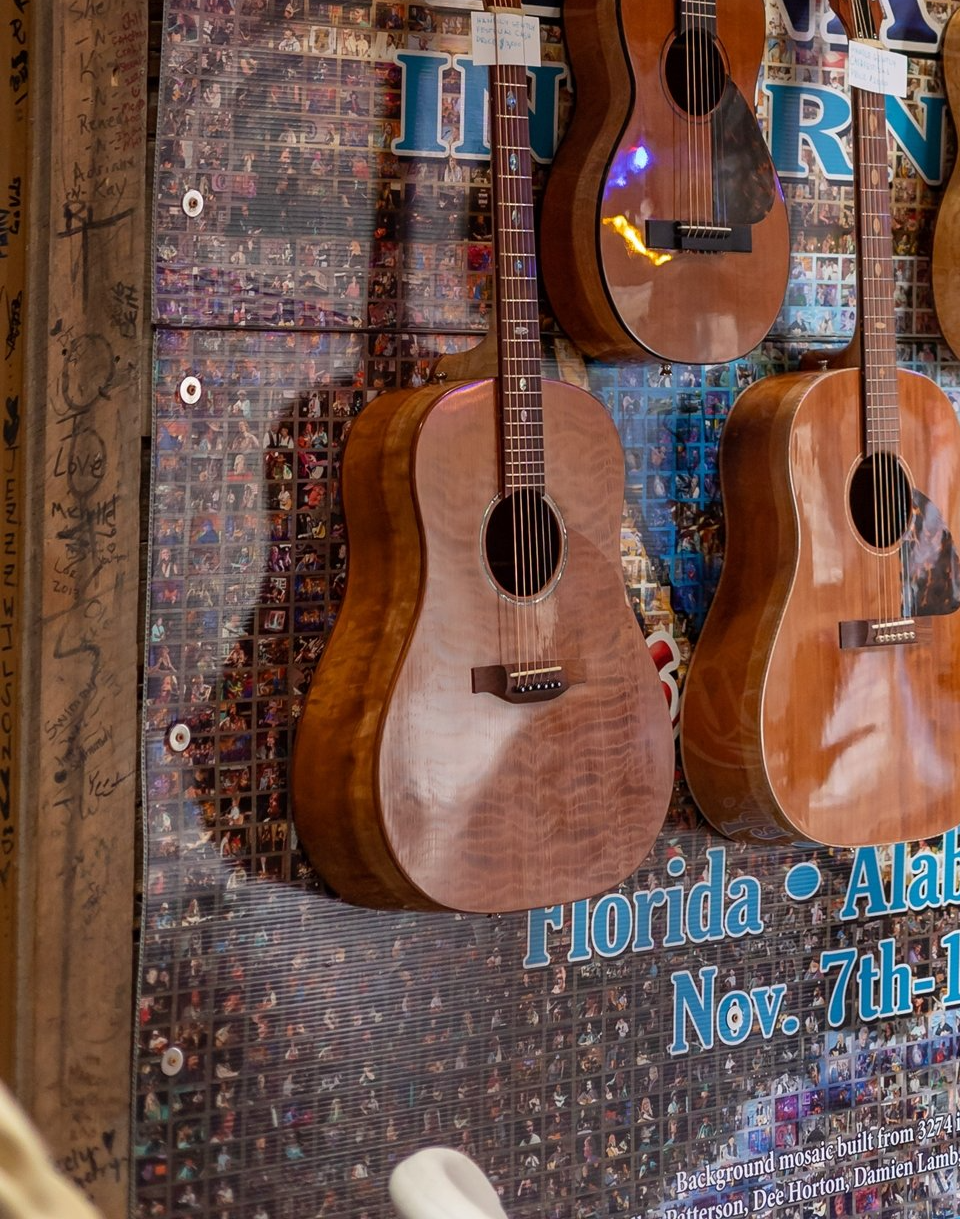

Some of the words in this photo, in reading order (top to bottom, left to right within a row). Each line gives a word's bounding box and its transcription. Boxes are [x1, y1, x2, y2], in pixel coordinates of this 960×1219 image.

[523, 847, 763, 970] Florida
[668, 964, 801, 1057] Nov.
[665, 1202, 749, 1219] Patterson,
[754, 1186, 786, 1213] Dee
[788, 1175, 851, 1206] Horton,
[854, 1157, 915, 1189] Damien
[676, 1150, 776, 1194] Background
[779, 1141, 834, 1170] mosaic
[836, 1131, 874, 1157] built
[877, 1126, 915, 1149] from
[918, 1115, 953, 1141] 3274
